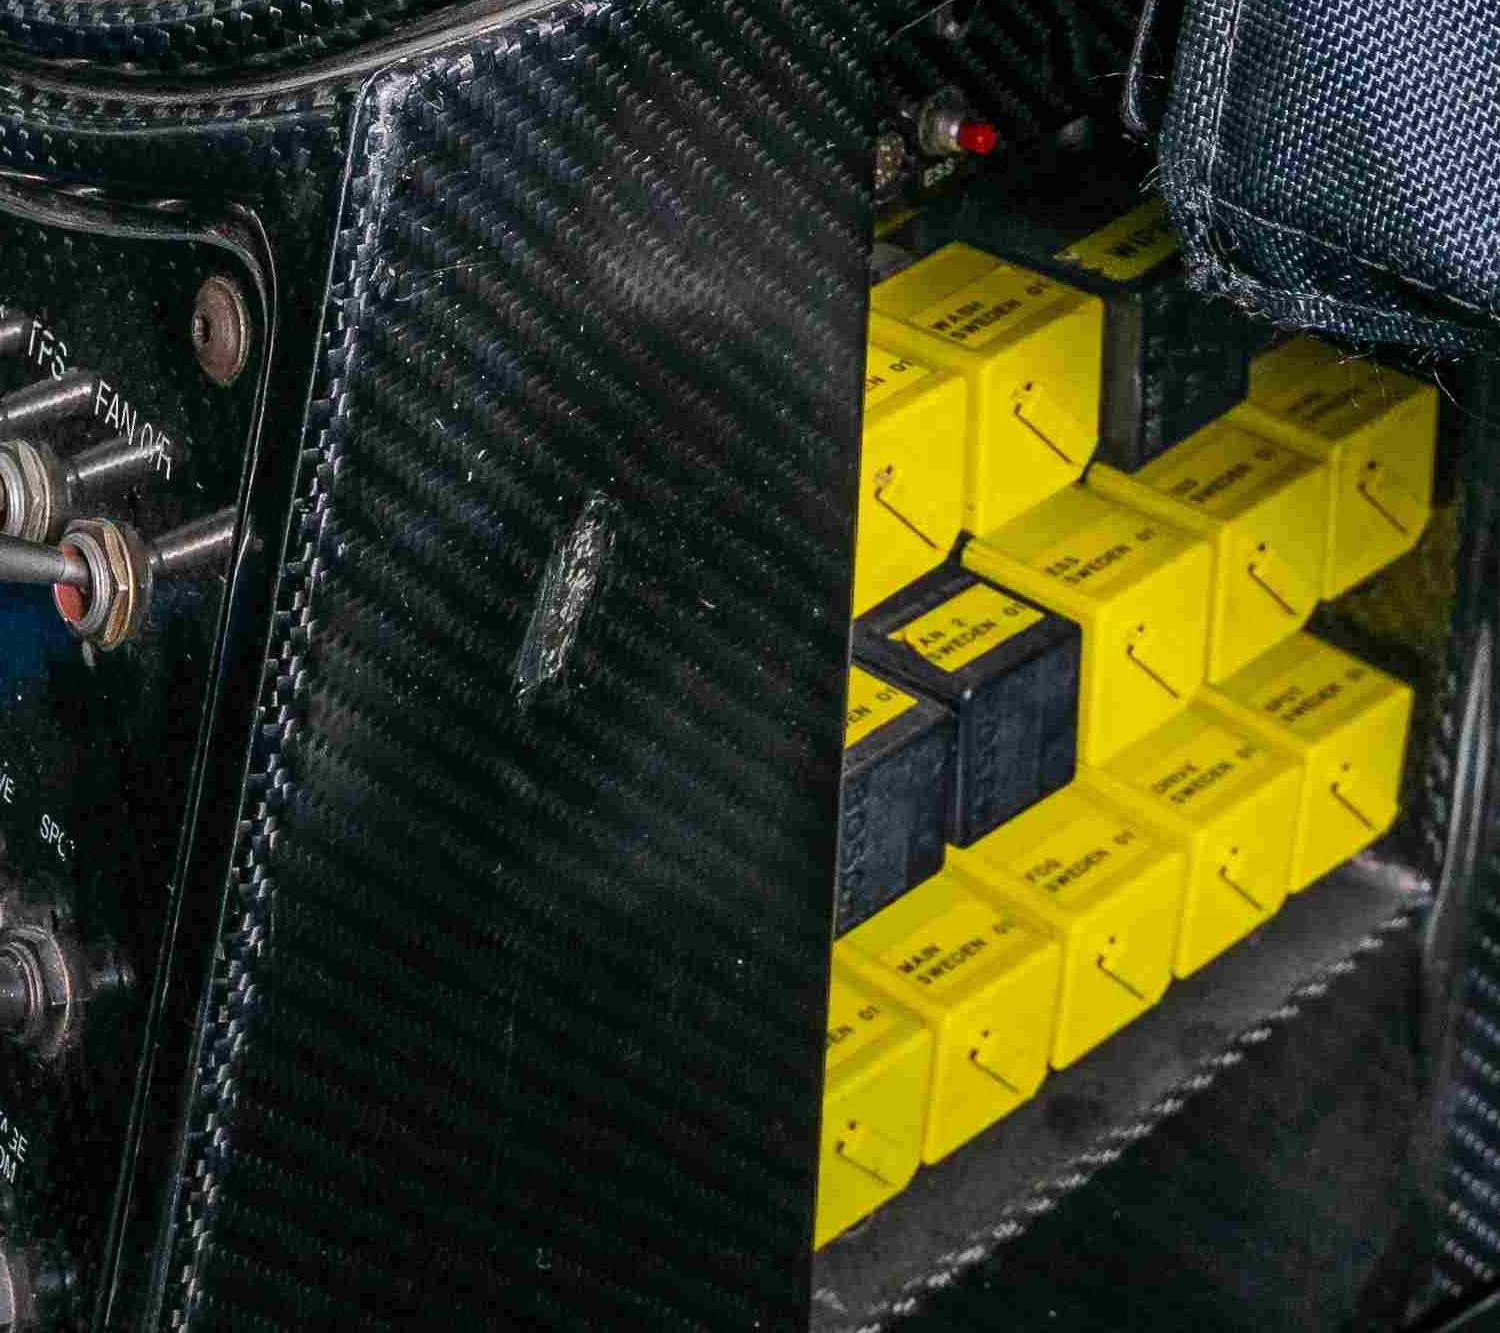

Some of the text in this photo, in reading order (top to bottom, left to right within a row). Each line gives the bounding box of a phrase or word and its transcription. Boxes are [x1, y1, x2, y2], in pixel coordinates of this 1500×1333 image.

[950, 298, 1022, 342] SWEDEN
[93, 380, 137, 446] FAN
[927, 619, 998, 662] SWEDEN
[39, 813, 77, 862] SPO
[896, 941, 942, 975] MAIN
[914, 938, 988, 985] SWEDEN
